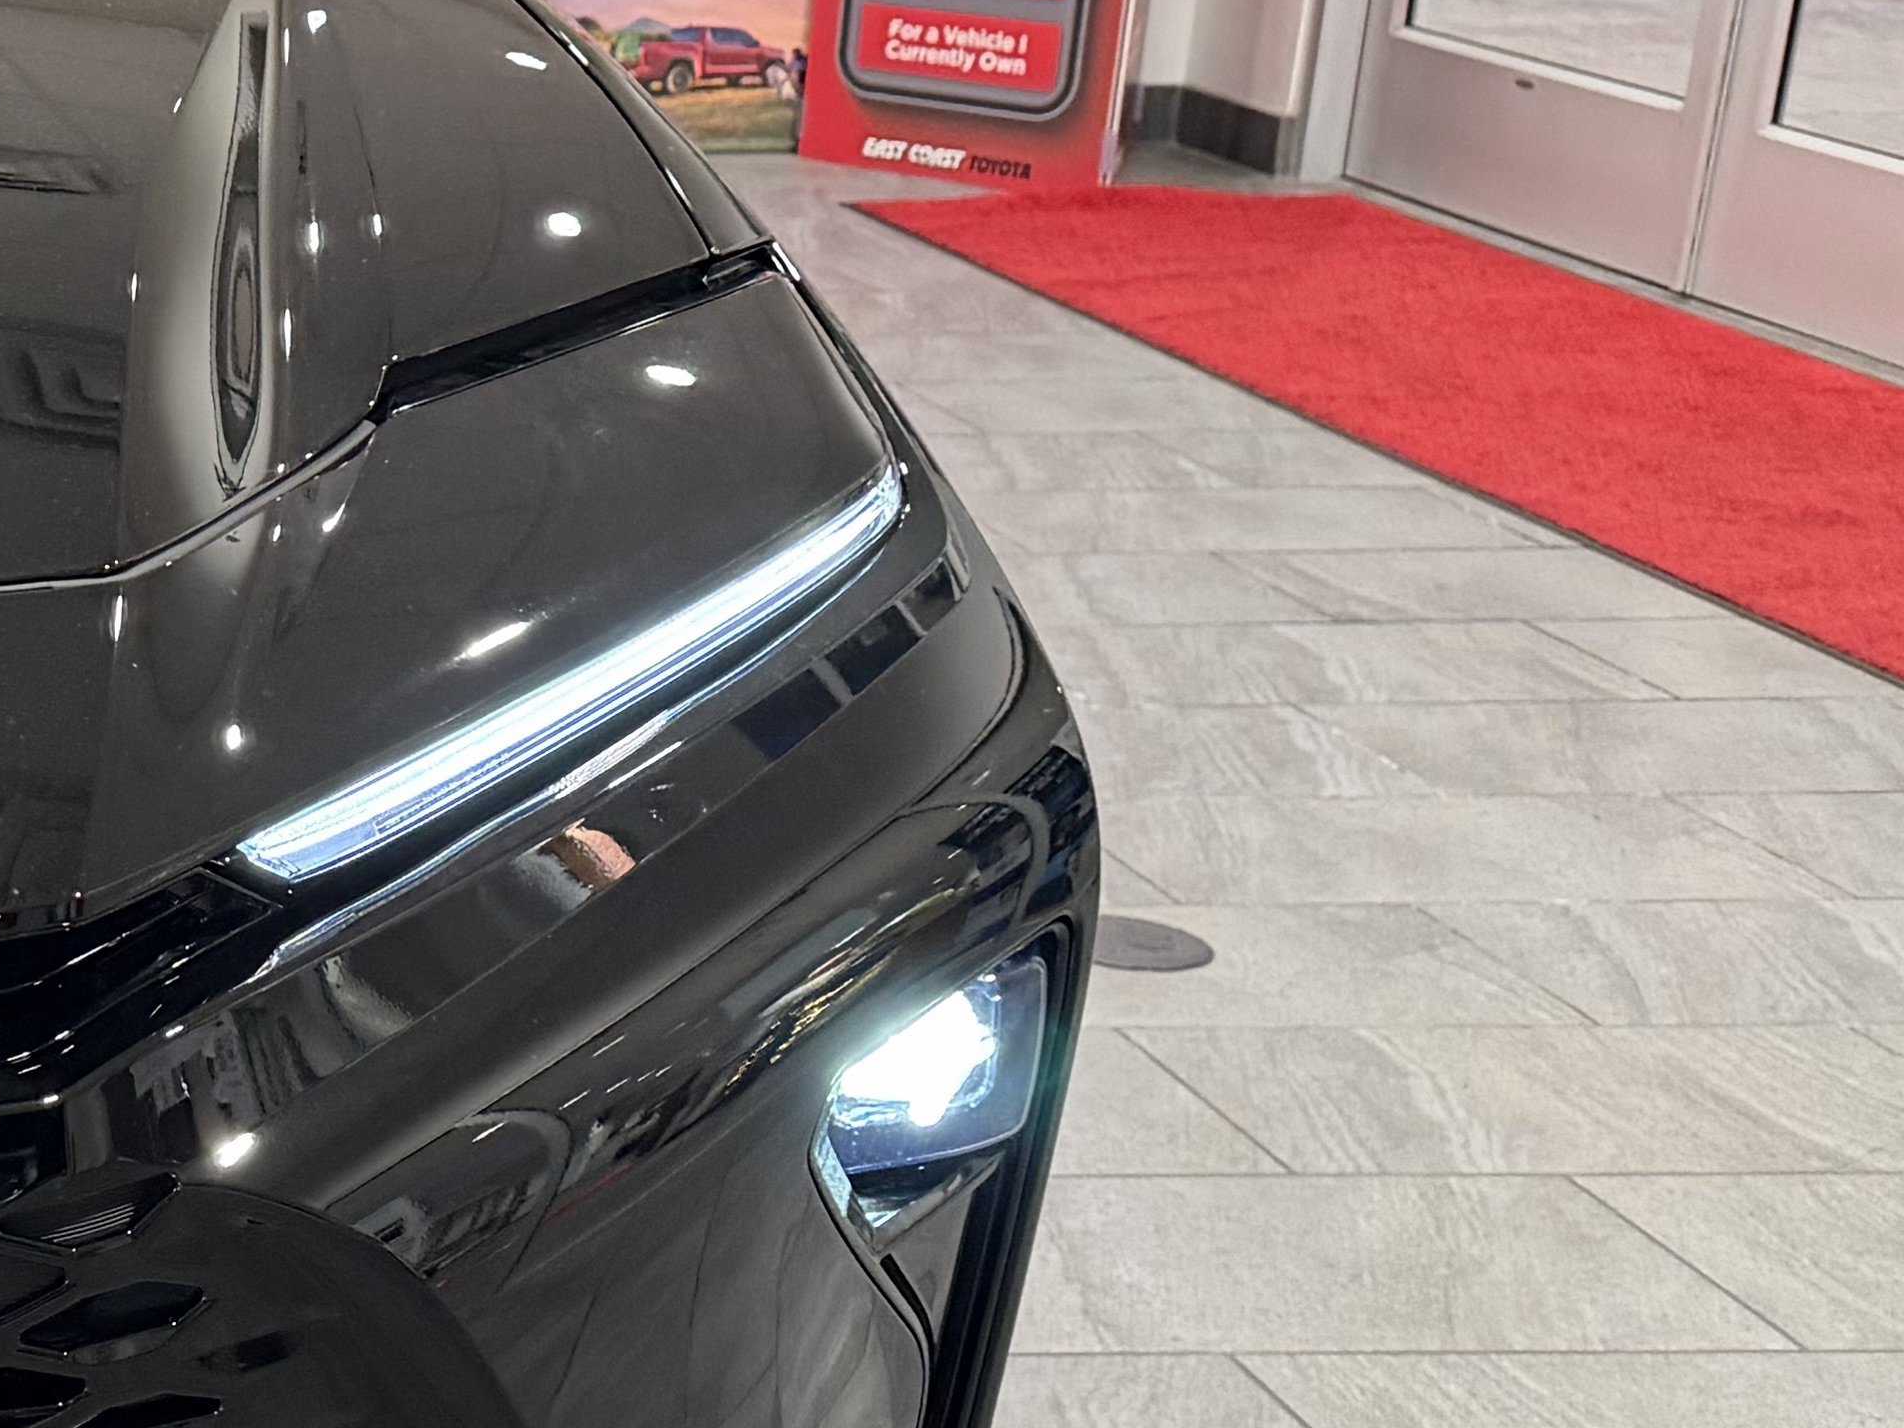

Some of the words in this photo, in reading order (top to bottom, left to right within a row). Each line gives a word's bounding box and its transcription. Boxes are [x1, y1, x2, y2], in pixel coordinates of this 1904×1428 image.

[888, 19, 921, 42] For
[925, 27, 939, 43] a
[942, 25, 1014, 52] Vehicle
[885, 40, 975, 72] Currently
[978, 52, 1027, 75] Own
[969, 156, 1032, 179] TOYOTA
